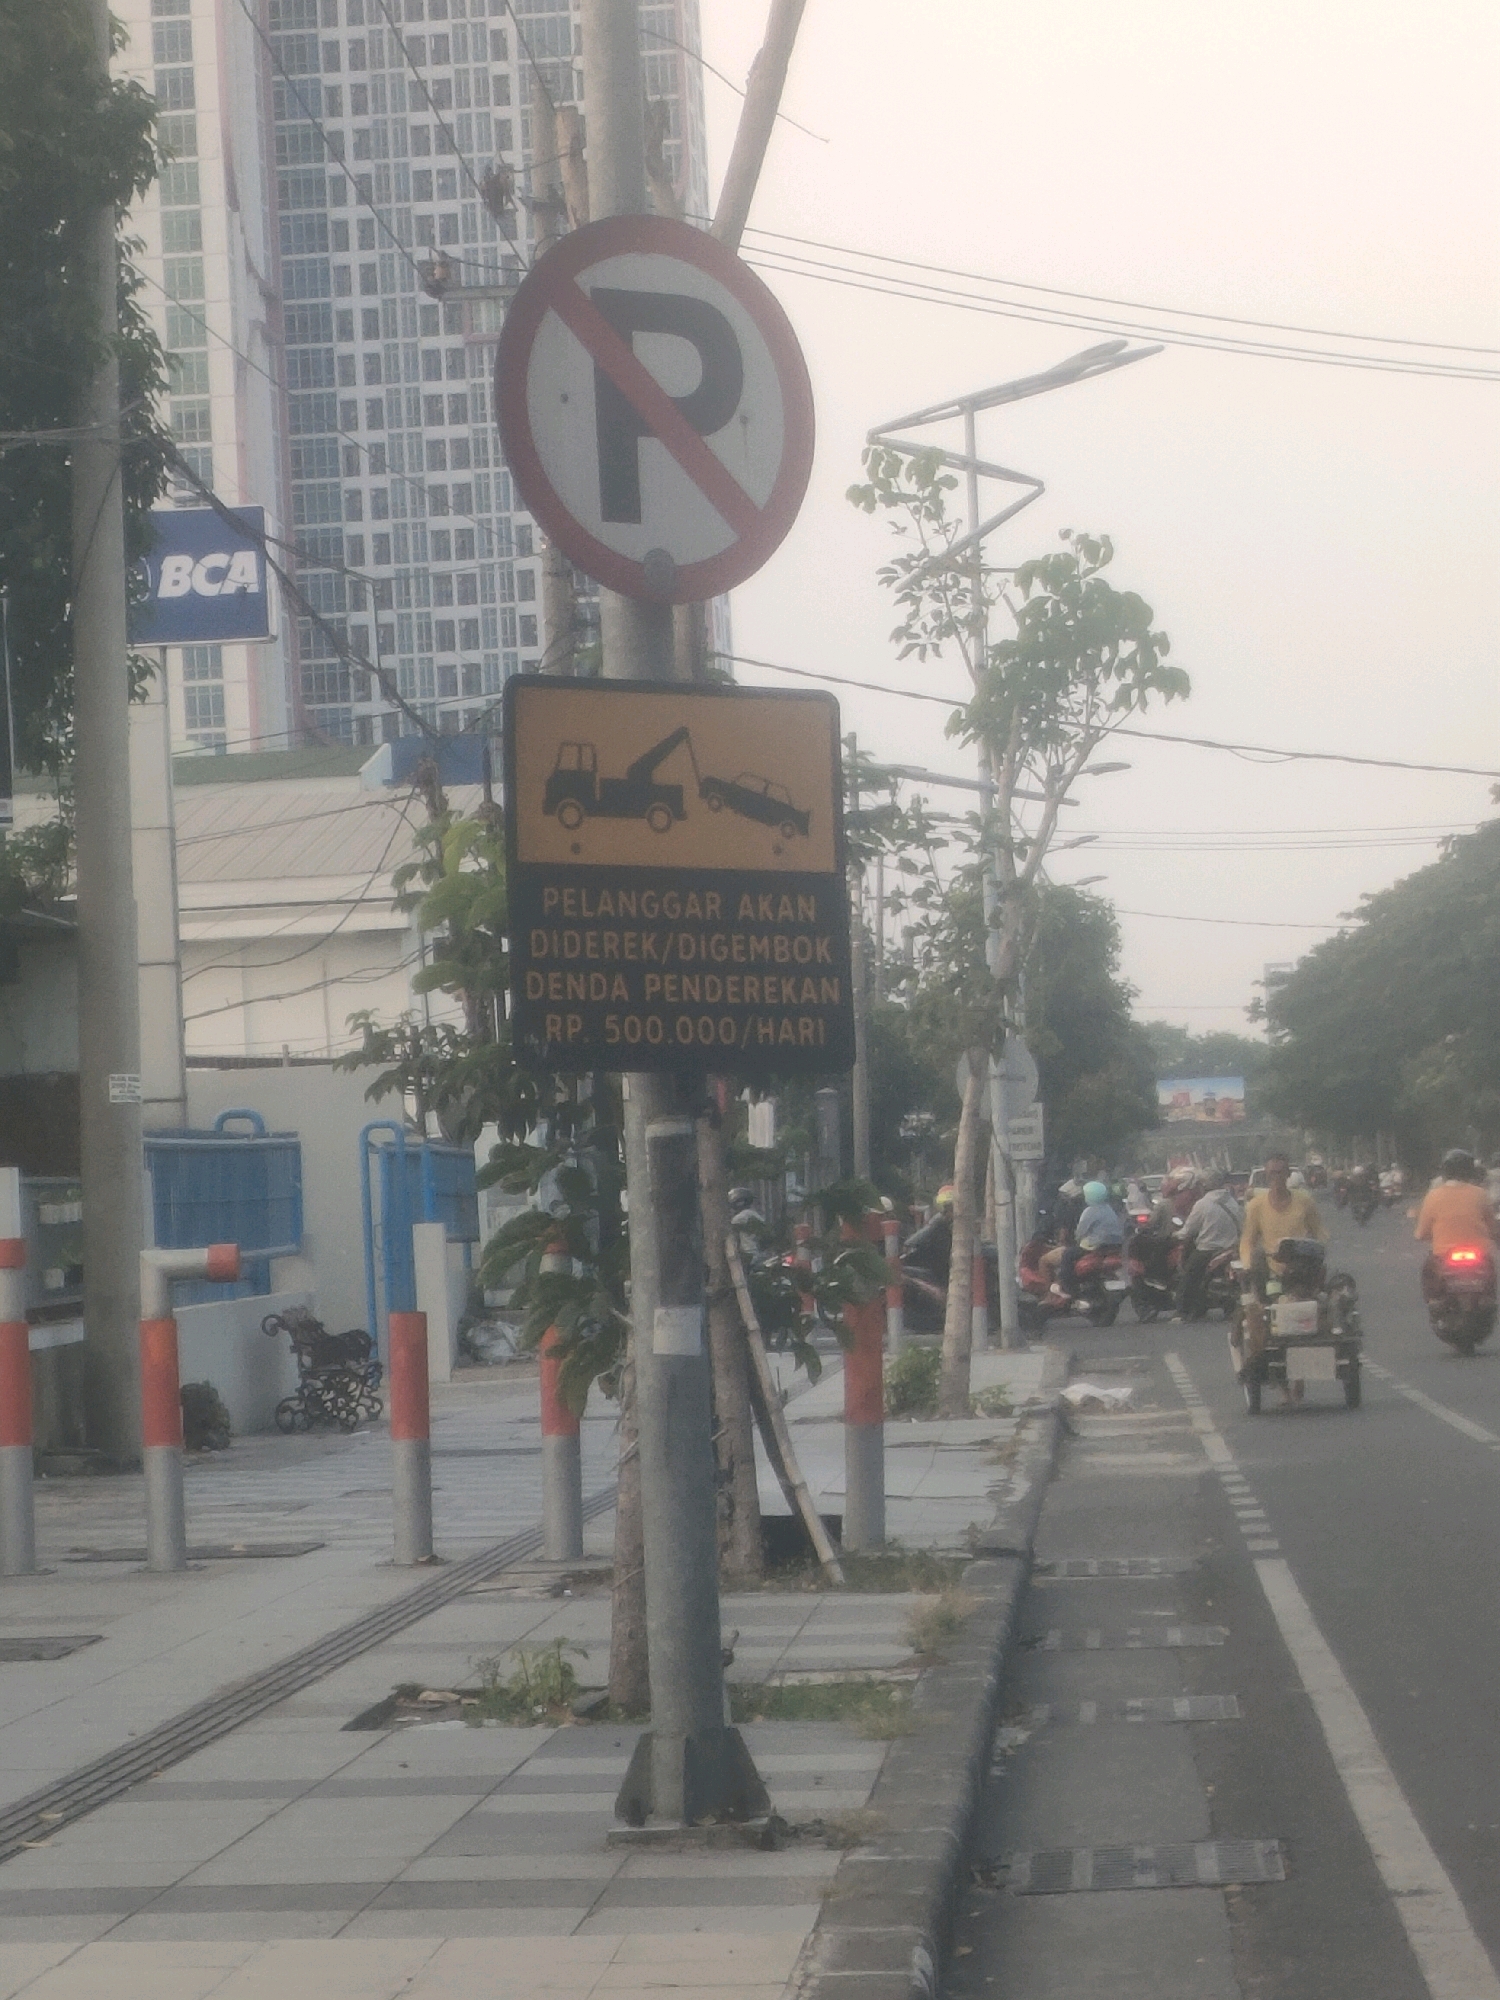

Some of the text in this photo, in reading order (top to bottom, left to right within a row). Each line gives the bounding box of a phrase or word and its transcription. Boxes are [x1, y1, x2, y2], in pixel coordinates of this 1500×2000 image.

[590, 287, 743, 524] P
[157, 551, 259, 598] BCA
[543, 887, 816, 922] PELANGGAR AKAN
[530, 929, 833, 964] DIDEREK/DIGEMBOK
[526, 971, 841, 1005] DENDA PENDEREKAN
[605, 1015, 826, 1049] 500.000/HARI
